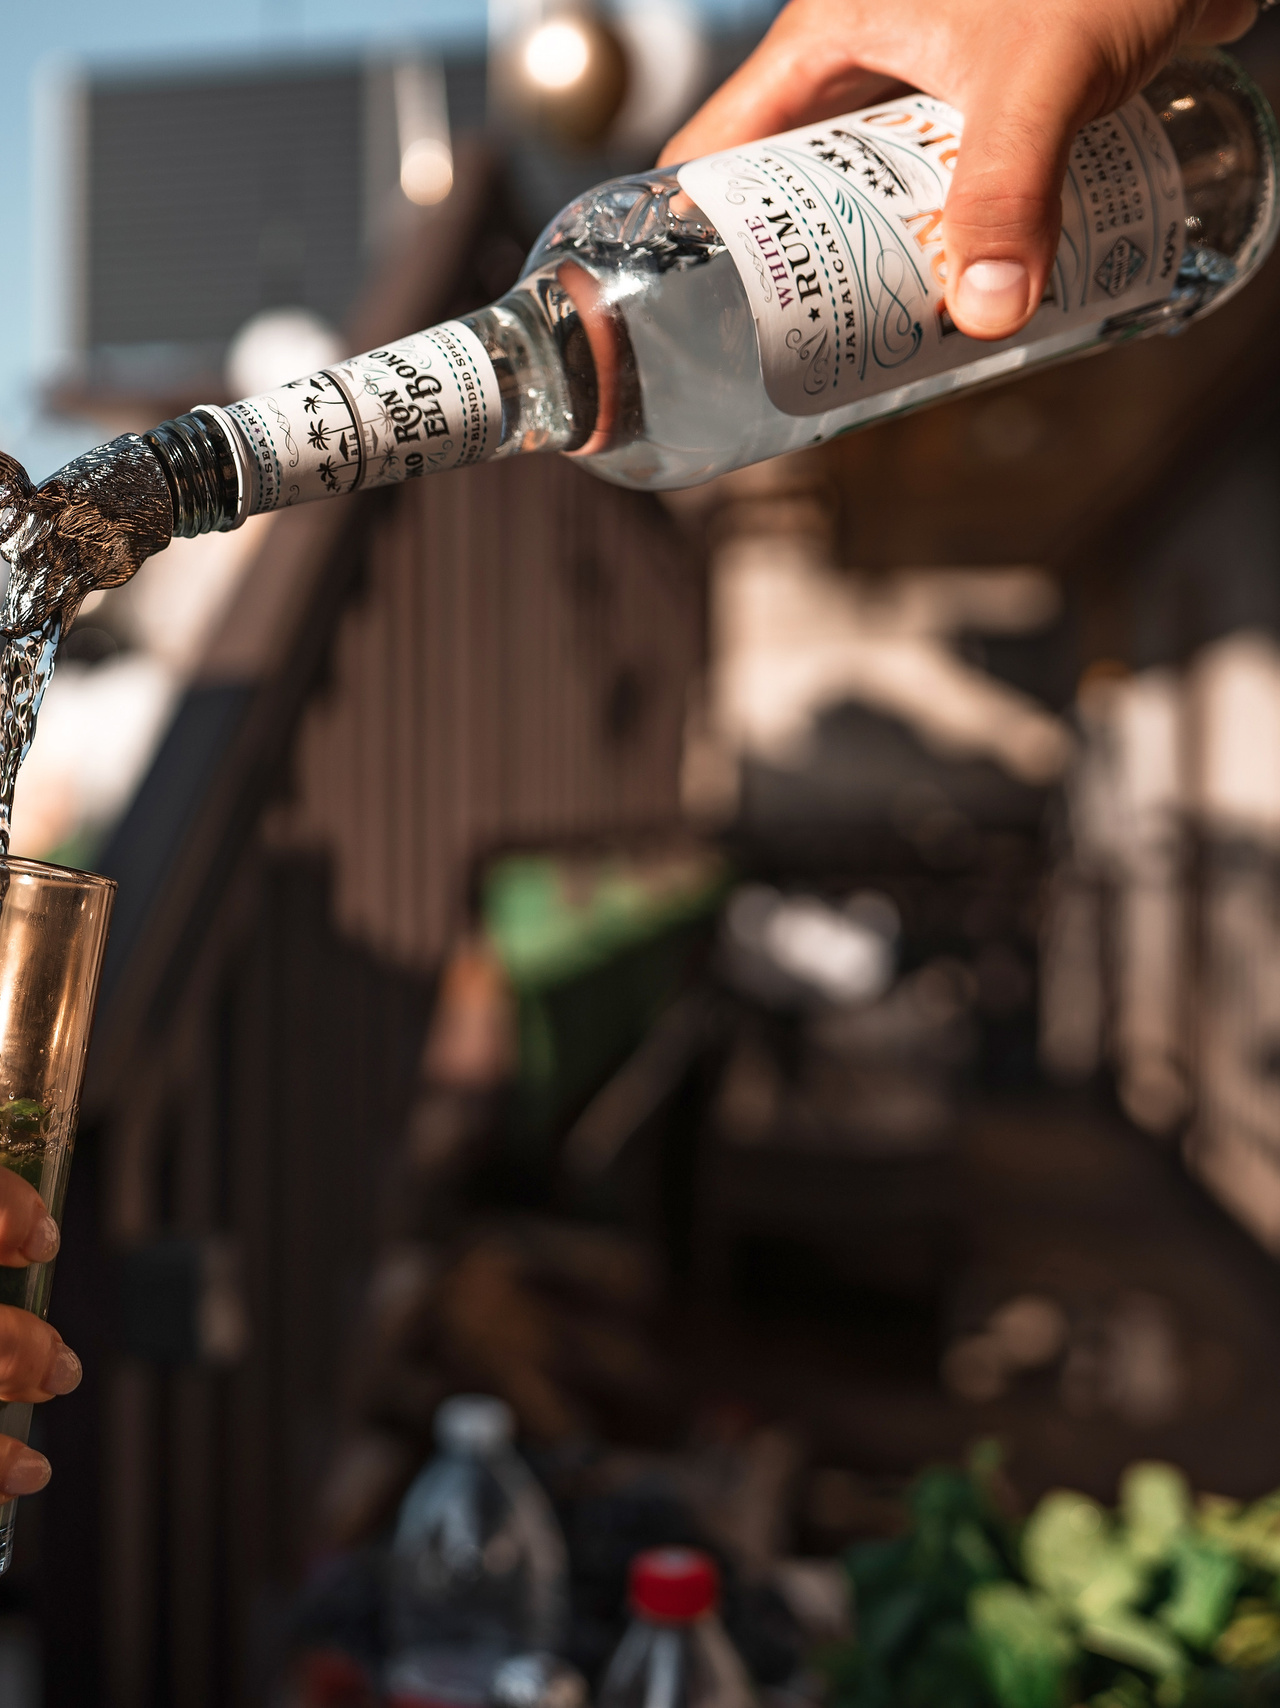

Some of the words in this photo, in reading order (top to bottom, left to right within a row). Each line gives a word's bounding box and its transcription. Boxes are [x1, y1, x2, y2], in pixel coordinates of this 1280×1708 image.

[759, 156, 818, 210] STYLE
[745, 217, 794, 311] WHITE
[764, 210, 824, 303] RUM
[818, 220, 857, 365] JAMAICAN
[369, 350, 442, 401] BOKO
[235, 402, 257, 427] RUM
[377, 388, 422, 446] RON
[424, 401, 450, 440] EL
[462, 372, 480, 441] BLENDED
[258, 438, 273, 474] SEA
